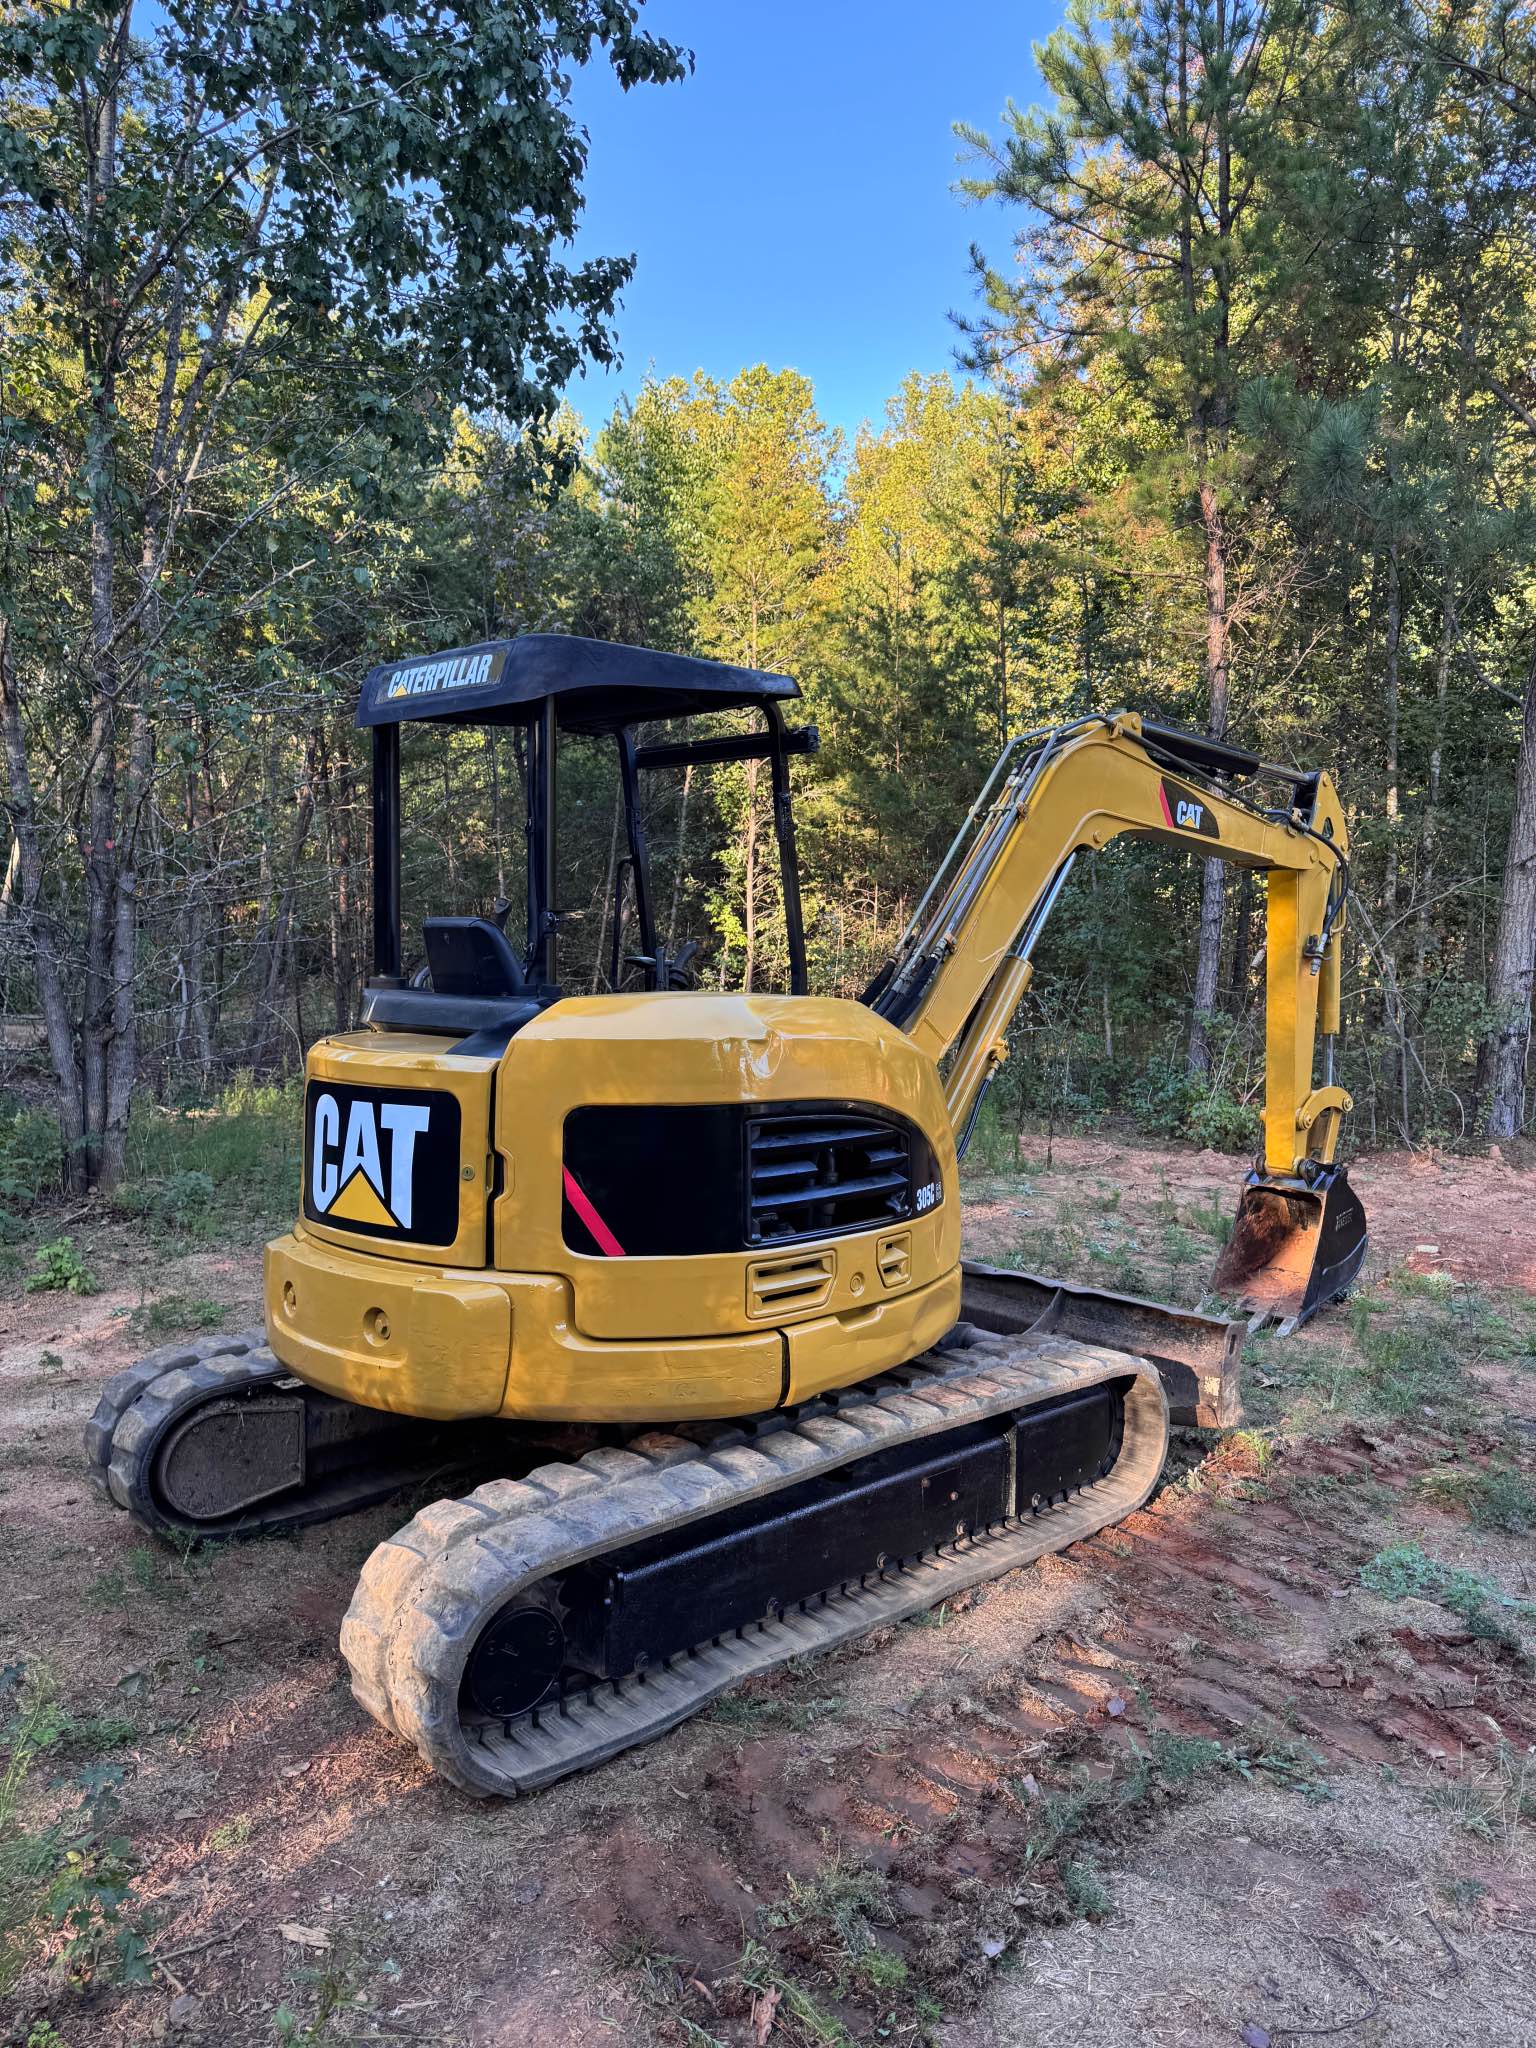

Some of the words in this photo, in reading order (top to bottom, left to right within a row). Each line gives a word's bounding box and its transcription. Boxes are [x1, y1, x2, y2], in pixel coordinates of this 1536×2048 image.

[388, 654, 493, 698] CATERPILLAR
[1176, 800, 1204, 830] CAT
[312, 1093, 431, 1230] CAT
[916, 1182, 935, 1211] 305C
